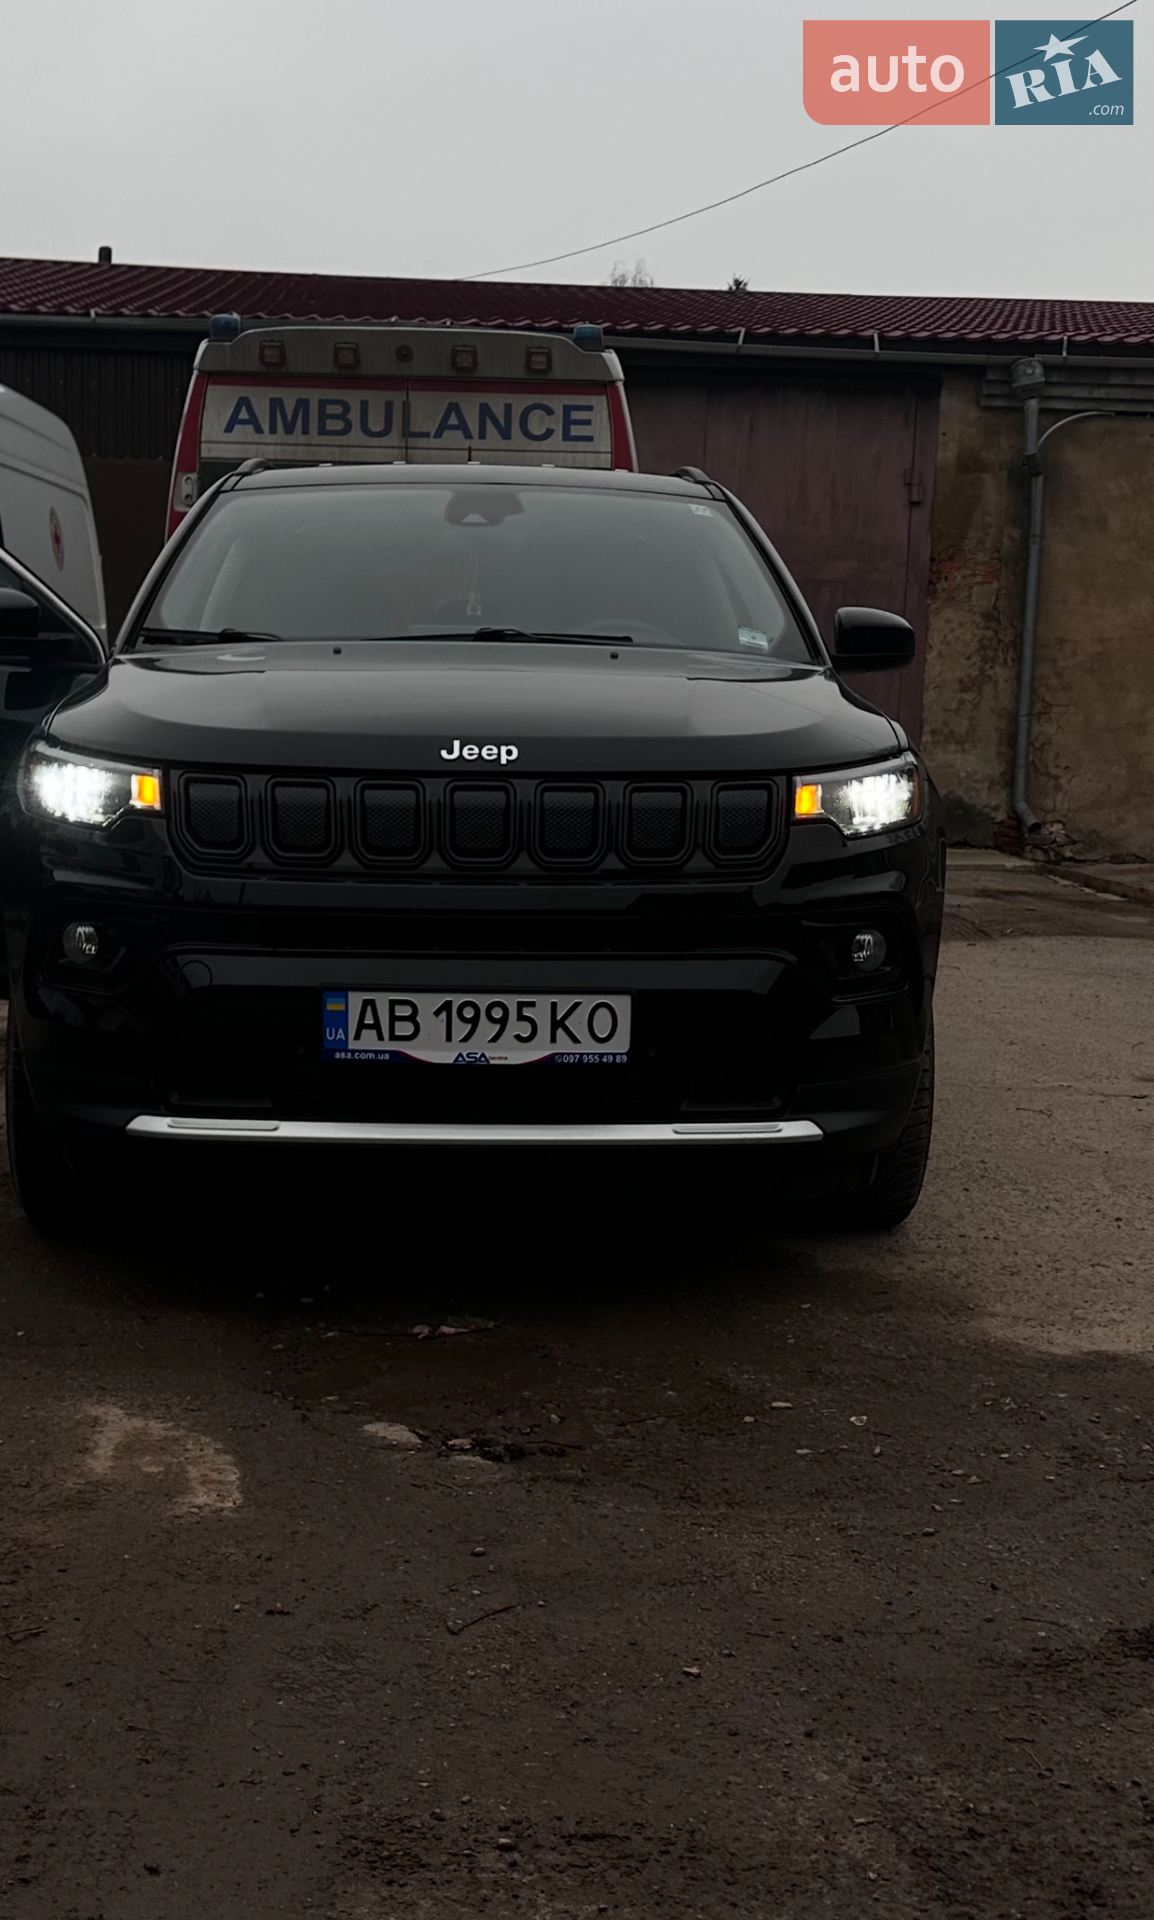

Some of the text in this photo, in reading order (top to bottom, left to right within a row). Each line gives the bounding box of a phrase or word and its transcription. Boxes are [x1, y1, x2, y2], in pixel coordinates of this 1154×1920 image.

[223, 396, 595, 443] AMBULANCE
[440, 740, 519, 765] Jeep
[326, 1028, 346, 1041] UA
[334, 1051, 390, 1061] asa.com.ua
[453, 1052, 490, 1064] ASA
